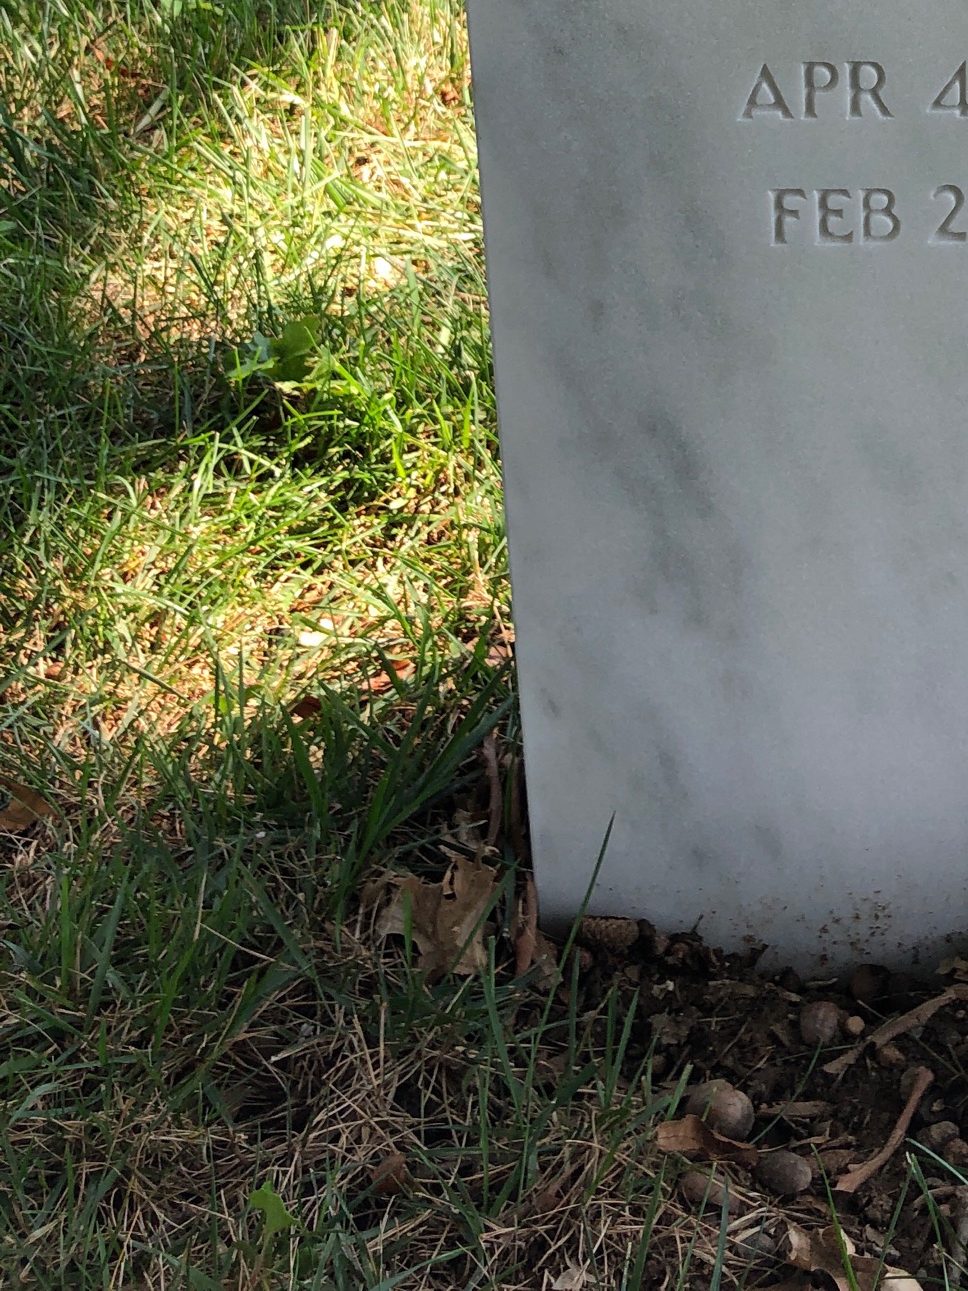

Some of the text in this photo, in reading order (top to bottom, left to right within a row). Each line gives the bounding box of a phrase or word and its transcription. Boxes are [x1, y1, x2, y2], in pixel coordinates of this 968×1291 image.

[737, 60, 895, 121] APR
[768, 188, 901, 246] FEB
[927, 184, 968, 243] 2
